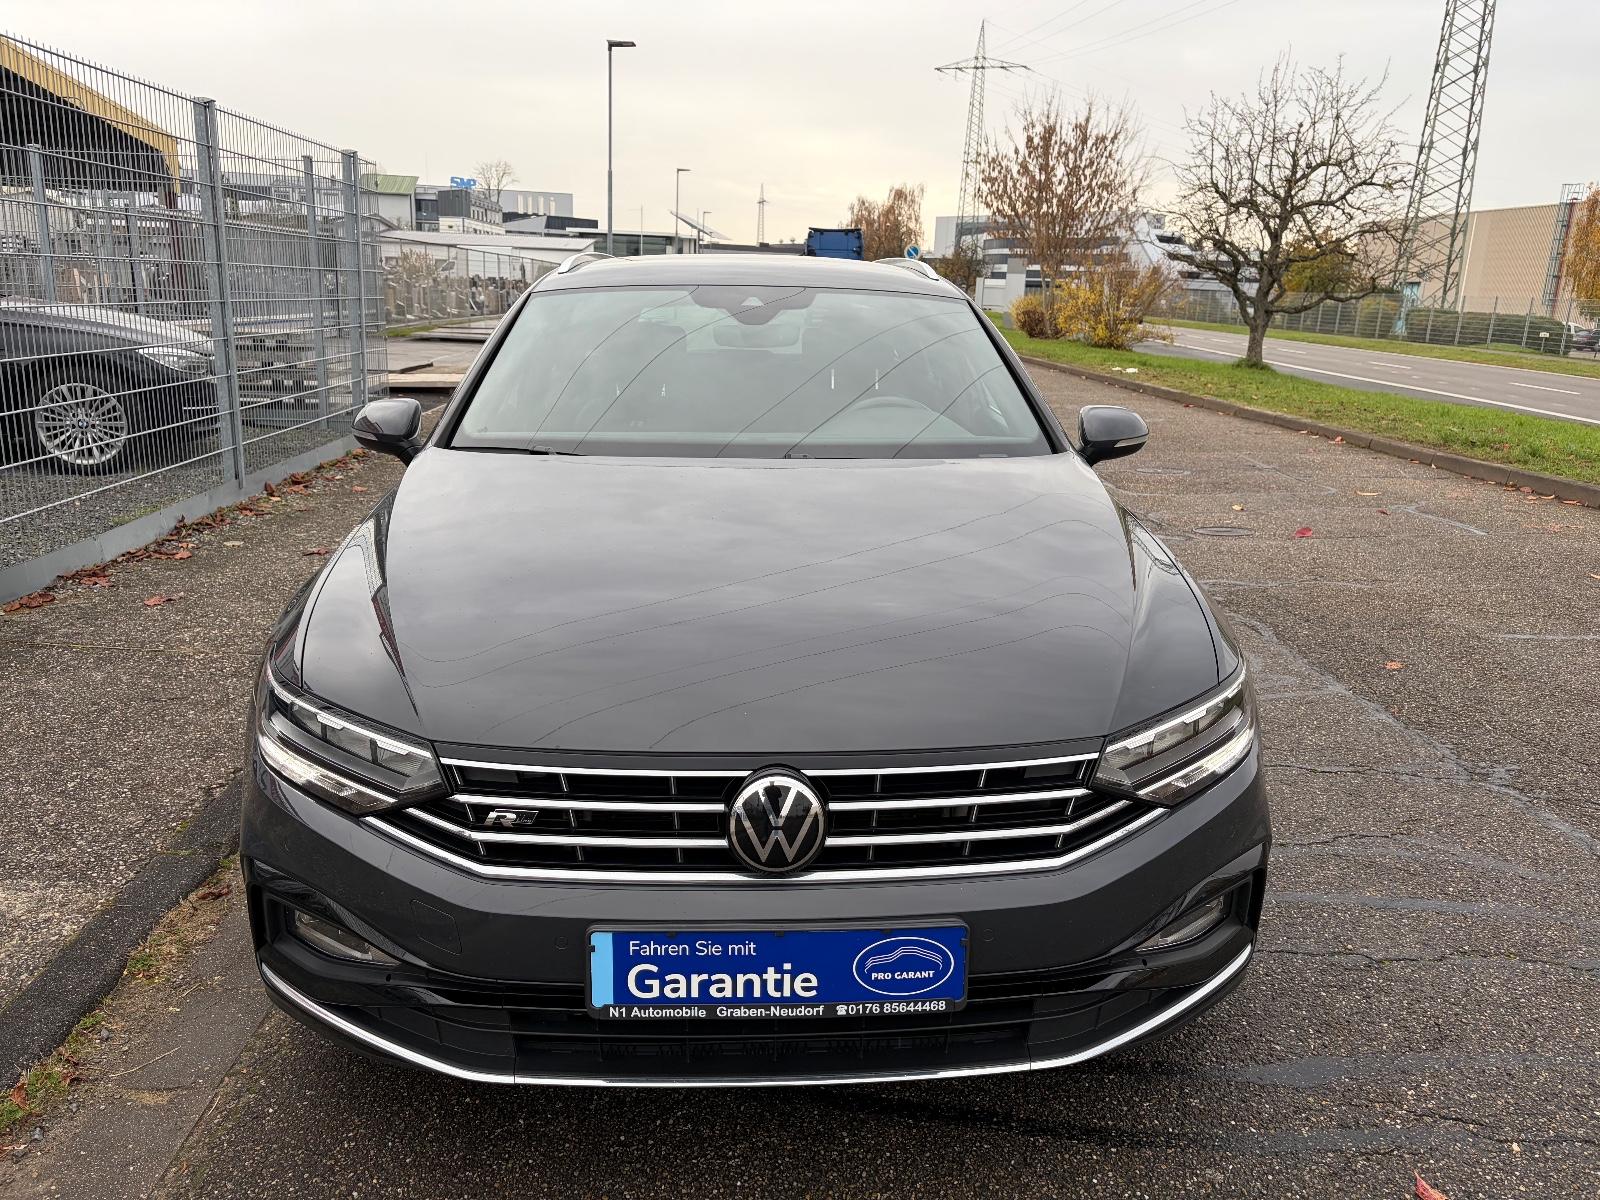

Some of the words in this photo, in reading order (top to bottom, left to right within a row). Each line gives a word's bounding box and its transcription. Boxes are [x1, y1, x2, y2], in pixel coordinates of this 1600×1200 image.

[629, 940, 689, 956] Fahren
[695, 940, 722, 956] Sie
[728, 940, 757, 956] mit
[627, 963, 818, 999] Garantie
[871, 972, 892, 981] PRO
[894, 970, 936, 980] GARANT
[609, 1006, 626, 1018] N1
[630, 1006, 707, 1018] Automobile
[716, 1005, 825, 1017] Graben-Neudorf
[848, 1003, 880, 1015] 0176
[883, 1000, 946, 1014] 85644468
